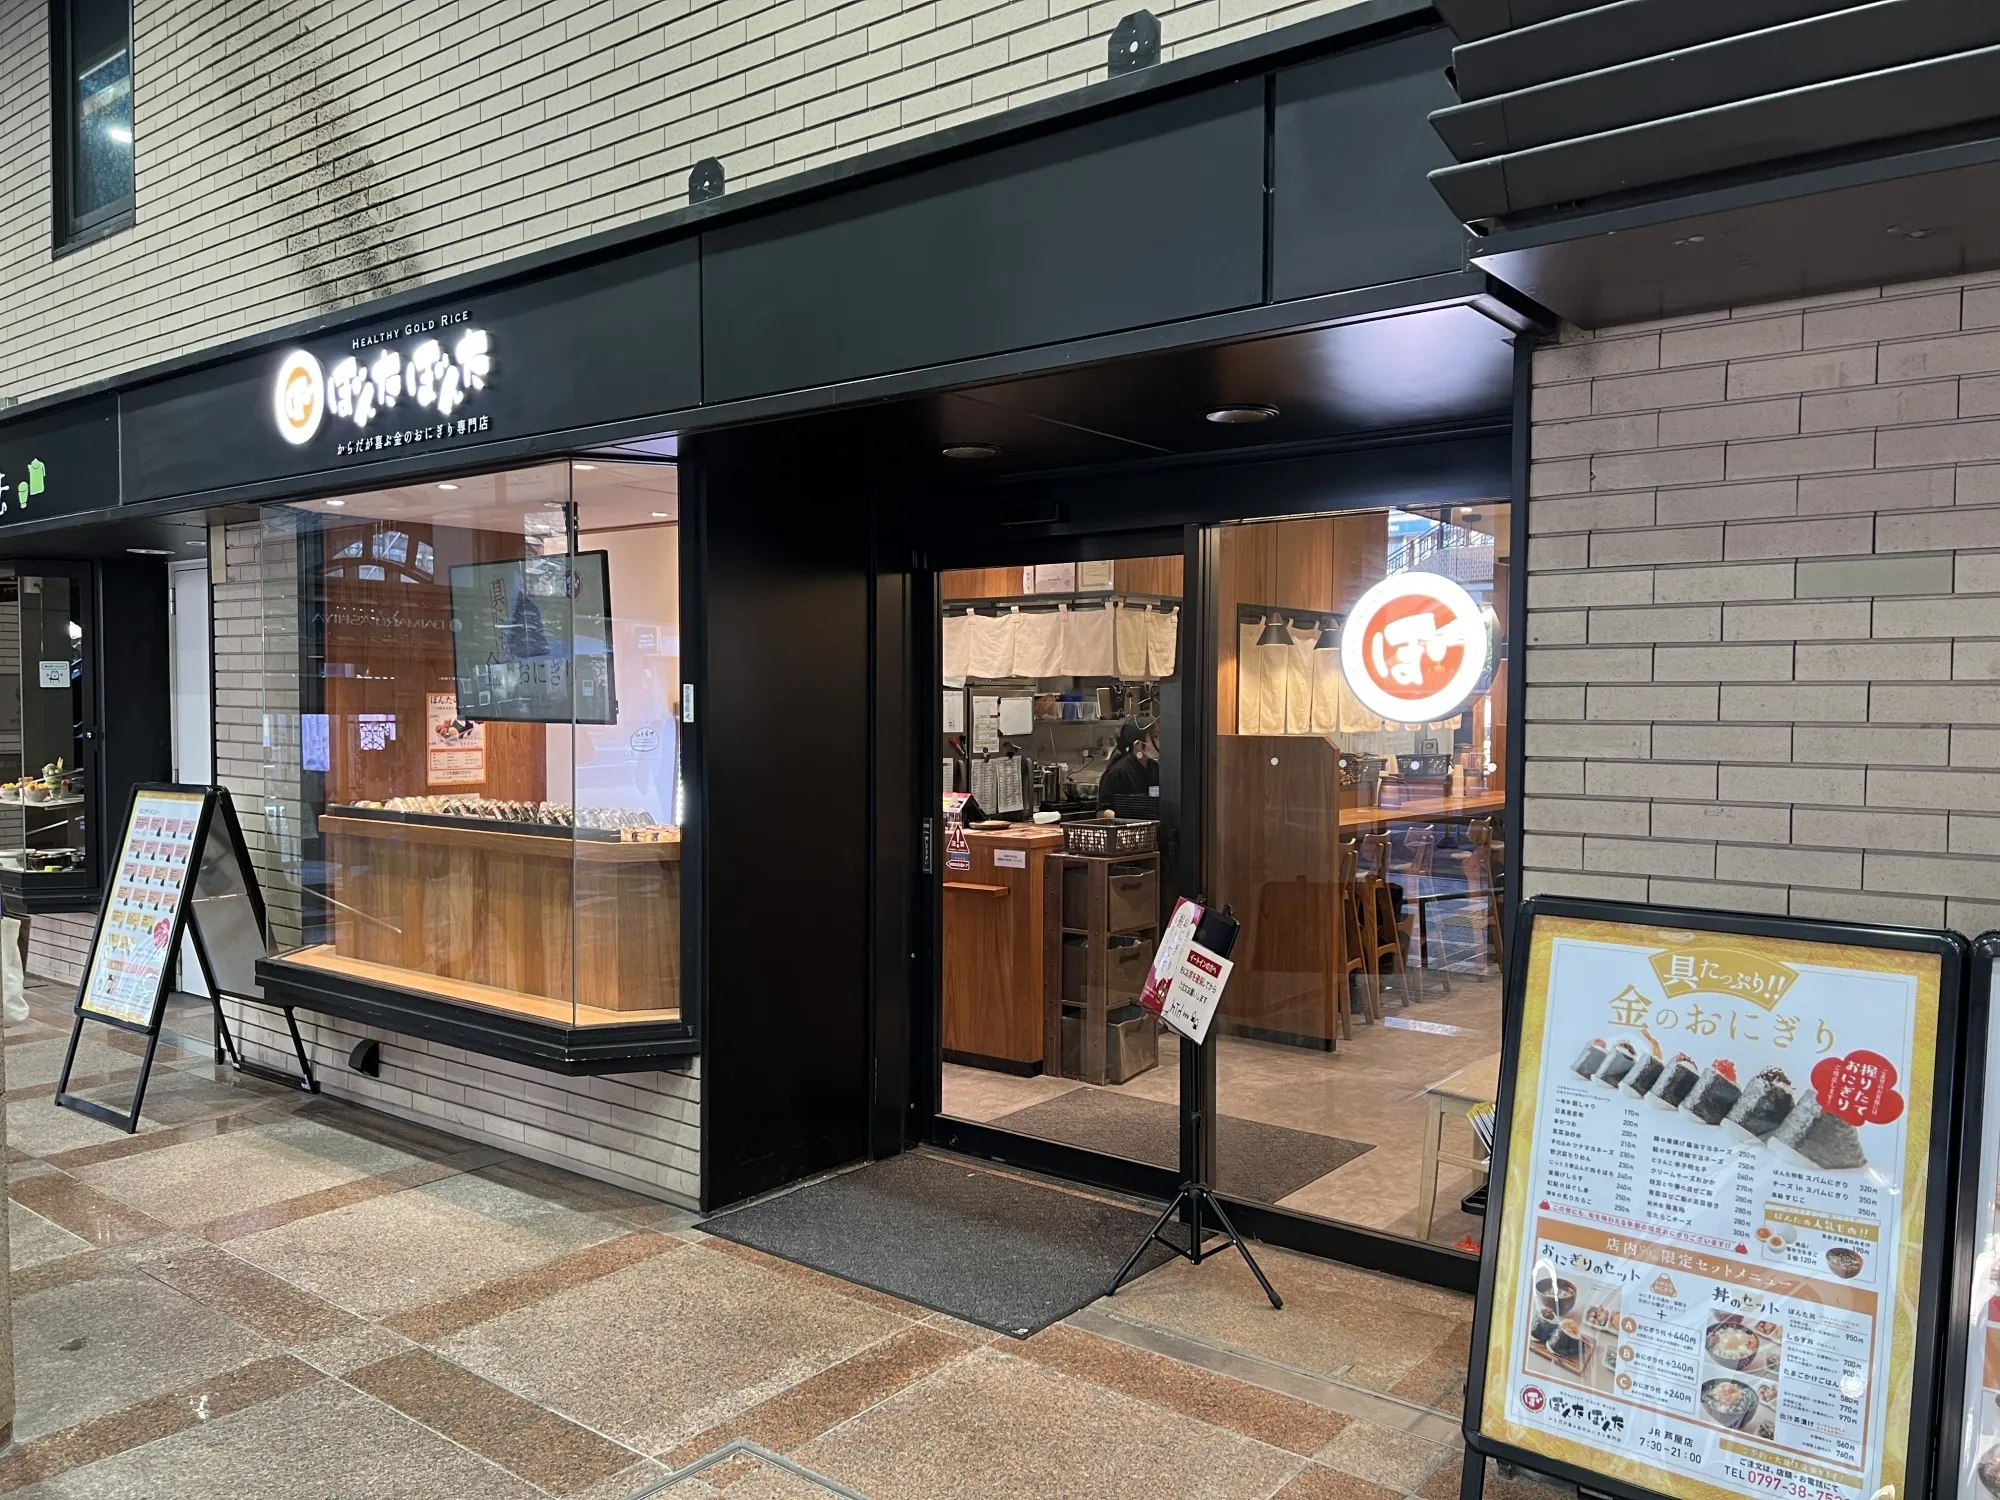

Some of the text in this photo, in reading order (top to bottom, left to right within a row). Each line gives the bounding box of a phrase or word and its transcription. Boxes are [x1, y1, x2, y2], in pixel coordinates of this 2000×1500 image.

[352, 310, 469, 350] HEALTHY GOLD RICE
[337, 415, 490, 455] からだが喜ぶ金のおにぎり専門店
[1663, 954, 1787, 999] 具たっぷり!!
[1608, 984, 1835, 1054] 金のおにぎり
[1838, 1060, 1860, 1111] おにぎり
[1854, 1063, 1878, 1116] 握りたて
[1624, 1109, 1640, 1118] 170円
[1622, 1119, 1639, 1128] 200円
[1621, 1130, 1637, 1139] 200円
[1620, 1140, 1636, 1149] 210円
[1619, 1151, 1635, 1160] 230円
[1738, 1150, 1756, 1160] 250円
[1618, 1161, 1634, 1171] 230円
[1737, 1161, 1755, 1171] 250円
[1617, 1172, 1632, 1181] 240円
[1736, 1172, 1754, 1182] 260円
[1616, 1182, 1632, 1192] 240円
[1735, 1184, 1753, 1193] 270円
[1805, 1175, 1848, 1189] スパムにぎり
[1859, 1184, 1878, 1194] 320円
[1615, 1193, 1631, 1203] 250円
[1772, 1181, 1793, 1190] チーズ
[1806, 1186, 1849, 1201] スパムにぎり
[1858, 1196, 1877, 1206] 350円
[1735, 1195, 1752, 1205] 280円
[1614, 1204, 1630, 1213] 250円
[1734, 1206, 1751, 1216] 280円
[1857, 1207, 1876, 1217] 350円
[1733, 1218, 1751, 1227] 280円
[1733, 1229, 1750, 1239] 300円
[1852, 1246, 1870, 1255] 190円
[1542, 1243, 1641, 1282] おにぎりのセット
[1800, 1254, 1817, 1265] 120円
[1712, 1286, 1780, 1315] 丼のセット
[1788, 1308, 1816, 1320] ぼんた丼
[1637, 1324, 1666, 1337] おにぎり代
[1668, 1331, 1697, 1345] +440円
[1786, 1333, 1814, 1346] しらす丼
[1845, 1333, 1864, 1344] 950円
[1635, 1352, 1664, 1366] おにぎり代
[1666, 1360, 1694, 1374] +340円
[1843, 1359, 1862, 1370] 700円
[1783, 1368, 1839, 1388] たまごかけごはん
[1632, 1380, 1661, 1394] おにぎり代
[1664, 1389, 1692, 1403] +240円
[1840, 1394, 1859, 1406] 580円
[1839, 1404, 1858, 1415] 770円
[1779, 1412, 1815, 1428] 出汁茶漬け
[1838, 1414, 1857, 1425] 970円
[1648, 1427, 1694, 1448] JR 芦屋店
[1836, 1440, 1855, 1452] 560円
[1836, 1449, 1855, 1461] 760円
[1739, 1458, 1840, 1493] ご注文は、店頭・お電話にて
[1724, 1465, 1850, 1500] TEL 0797-38-75
